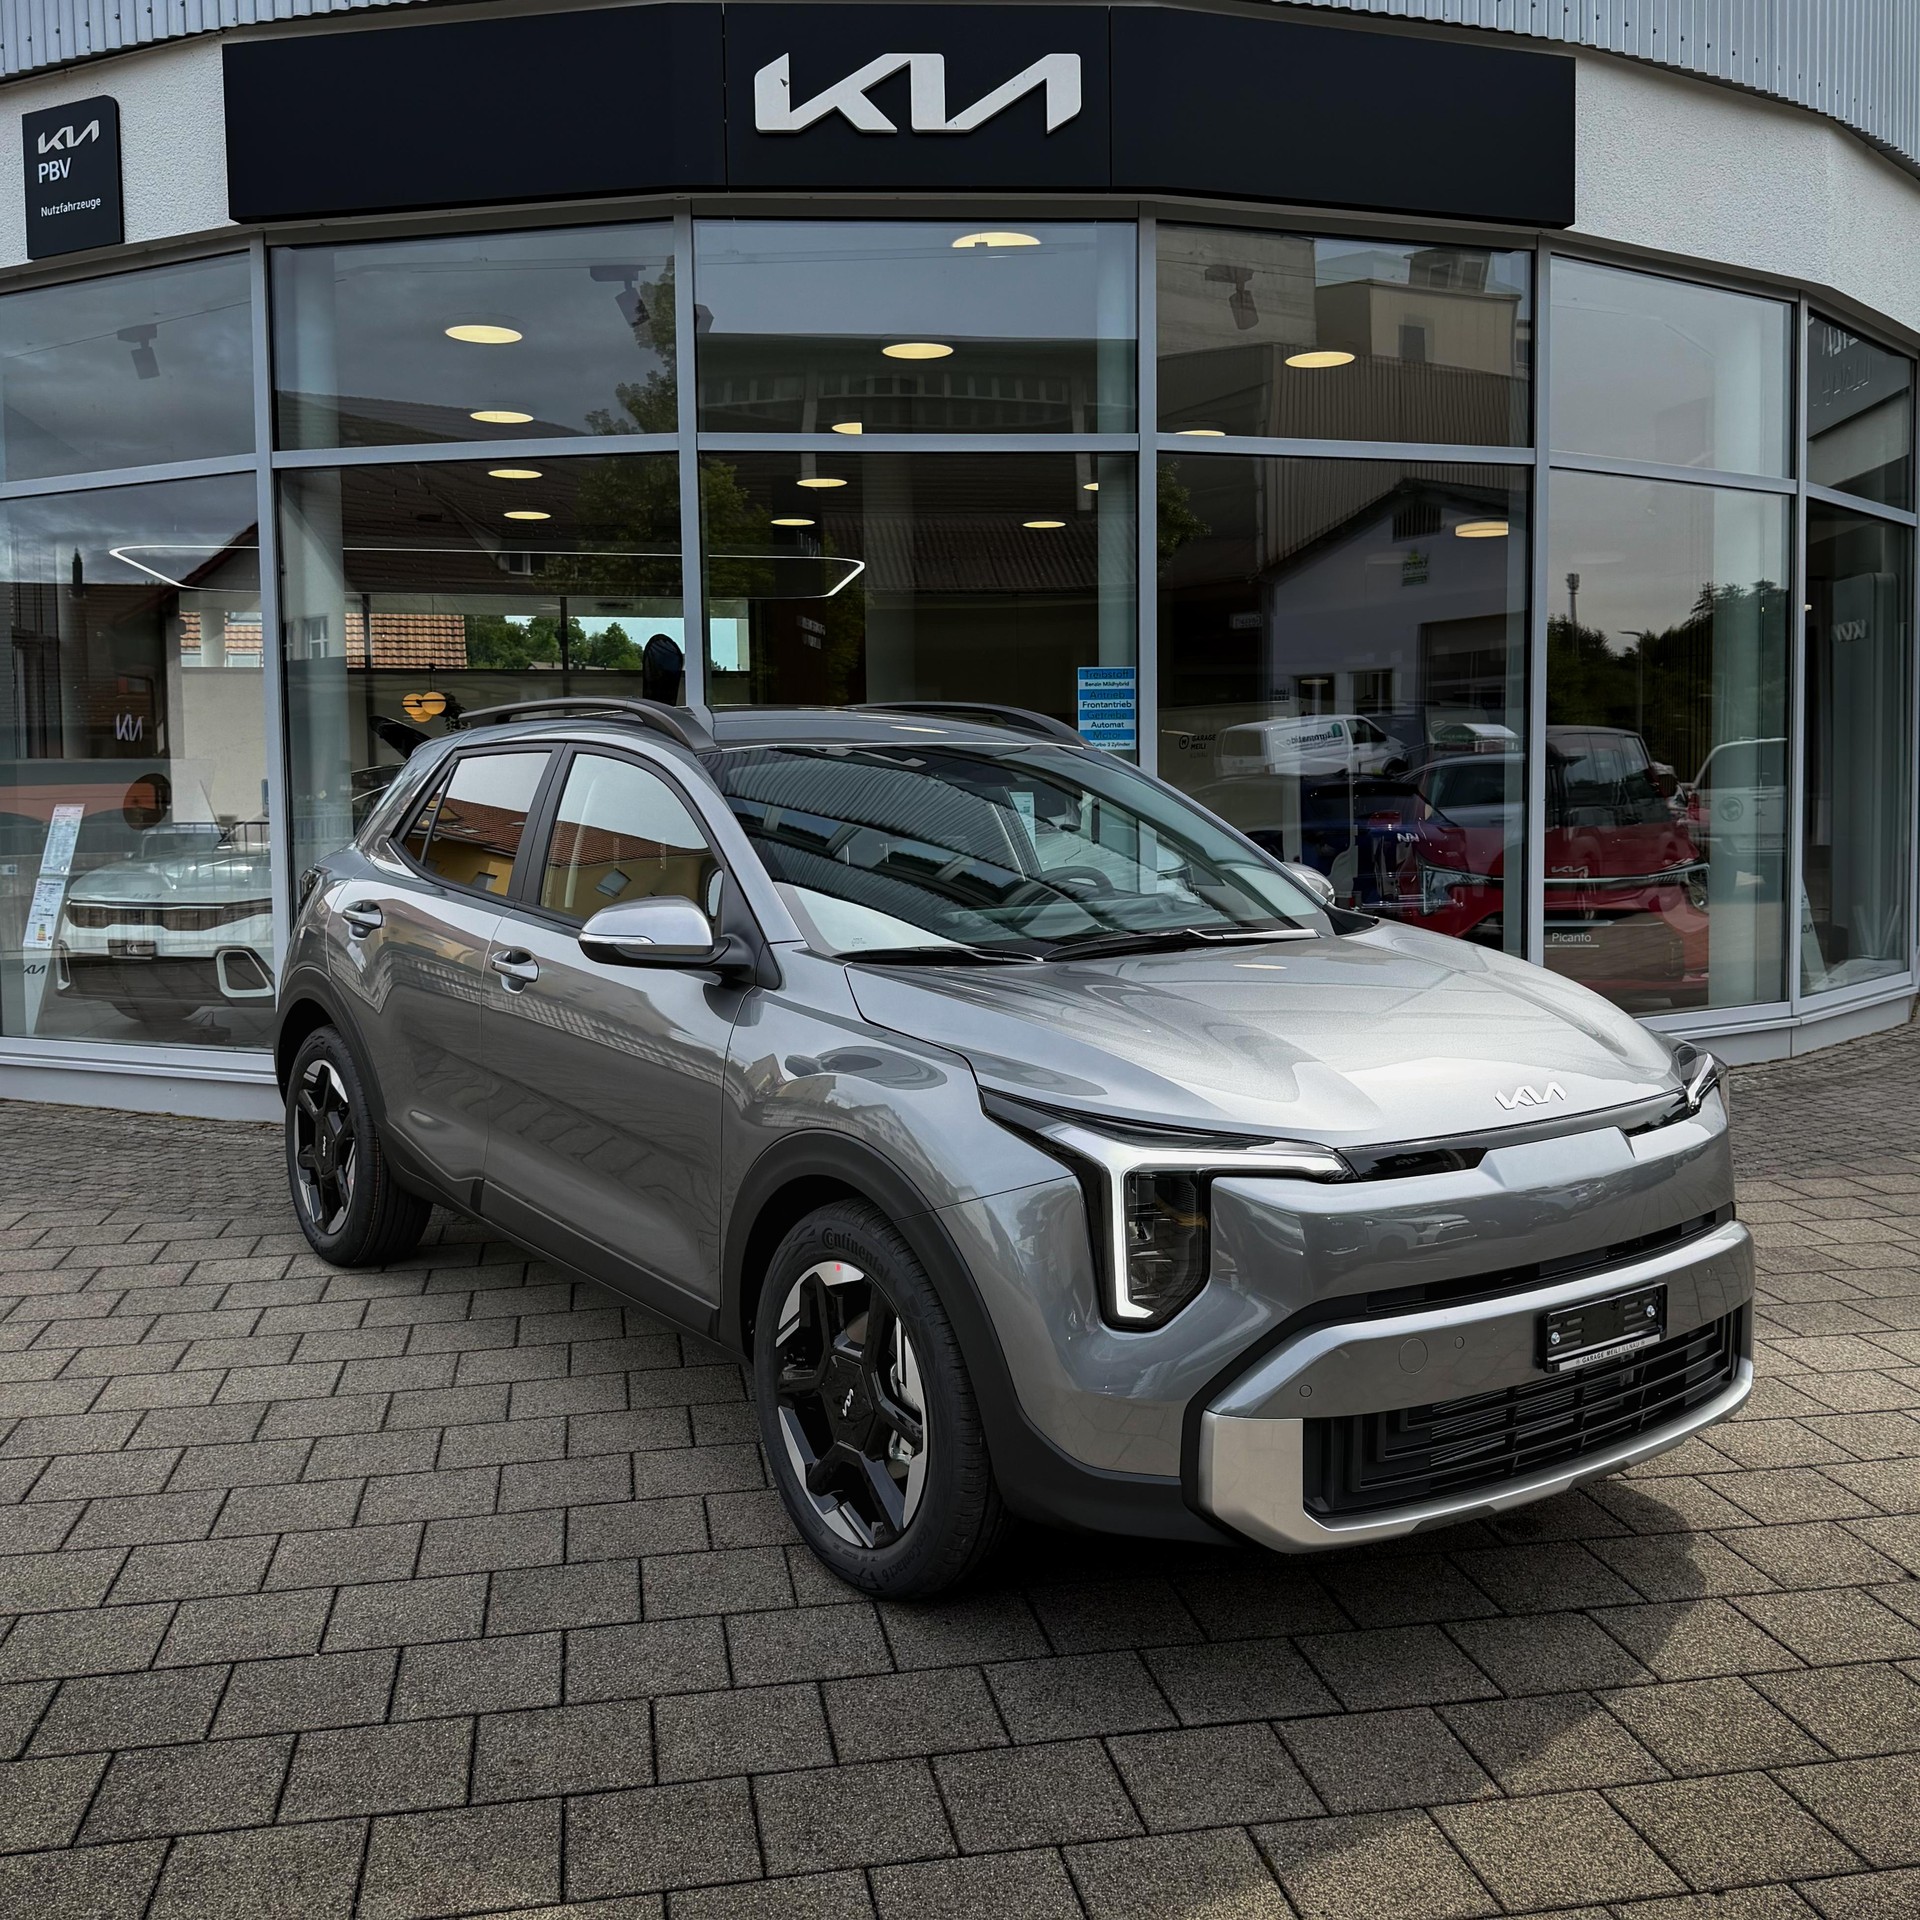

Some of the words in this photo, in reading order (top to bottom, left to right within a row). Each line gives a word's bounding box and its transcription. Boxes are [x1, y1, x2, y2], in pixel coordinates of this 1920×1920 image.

[754, 52, 1082, 134] KIA
[37, 119, 100, 155] KIA
[38, 157, 71, 184] PBV
[41, 198, 101, 217] Nutzfahrzeuge
[1090, 691, 1125, 699] Antrieb
[1192, 734, 1217, 742] GARAGE
[1552, 932, 1592, 943] Picanto
[1494, 1081, 1568, 1111] KIA
[822, 1227, 891, 1283] Continental
[1581, 1351, 1604, 1363] GARAGE
